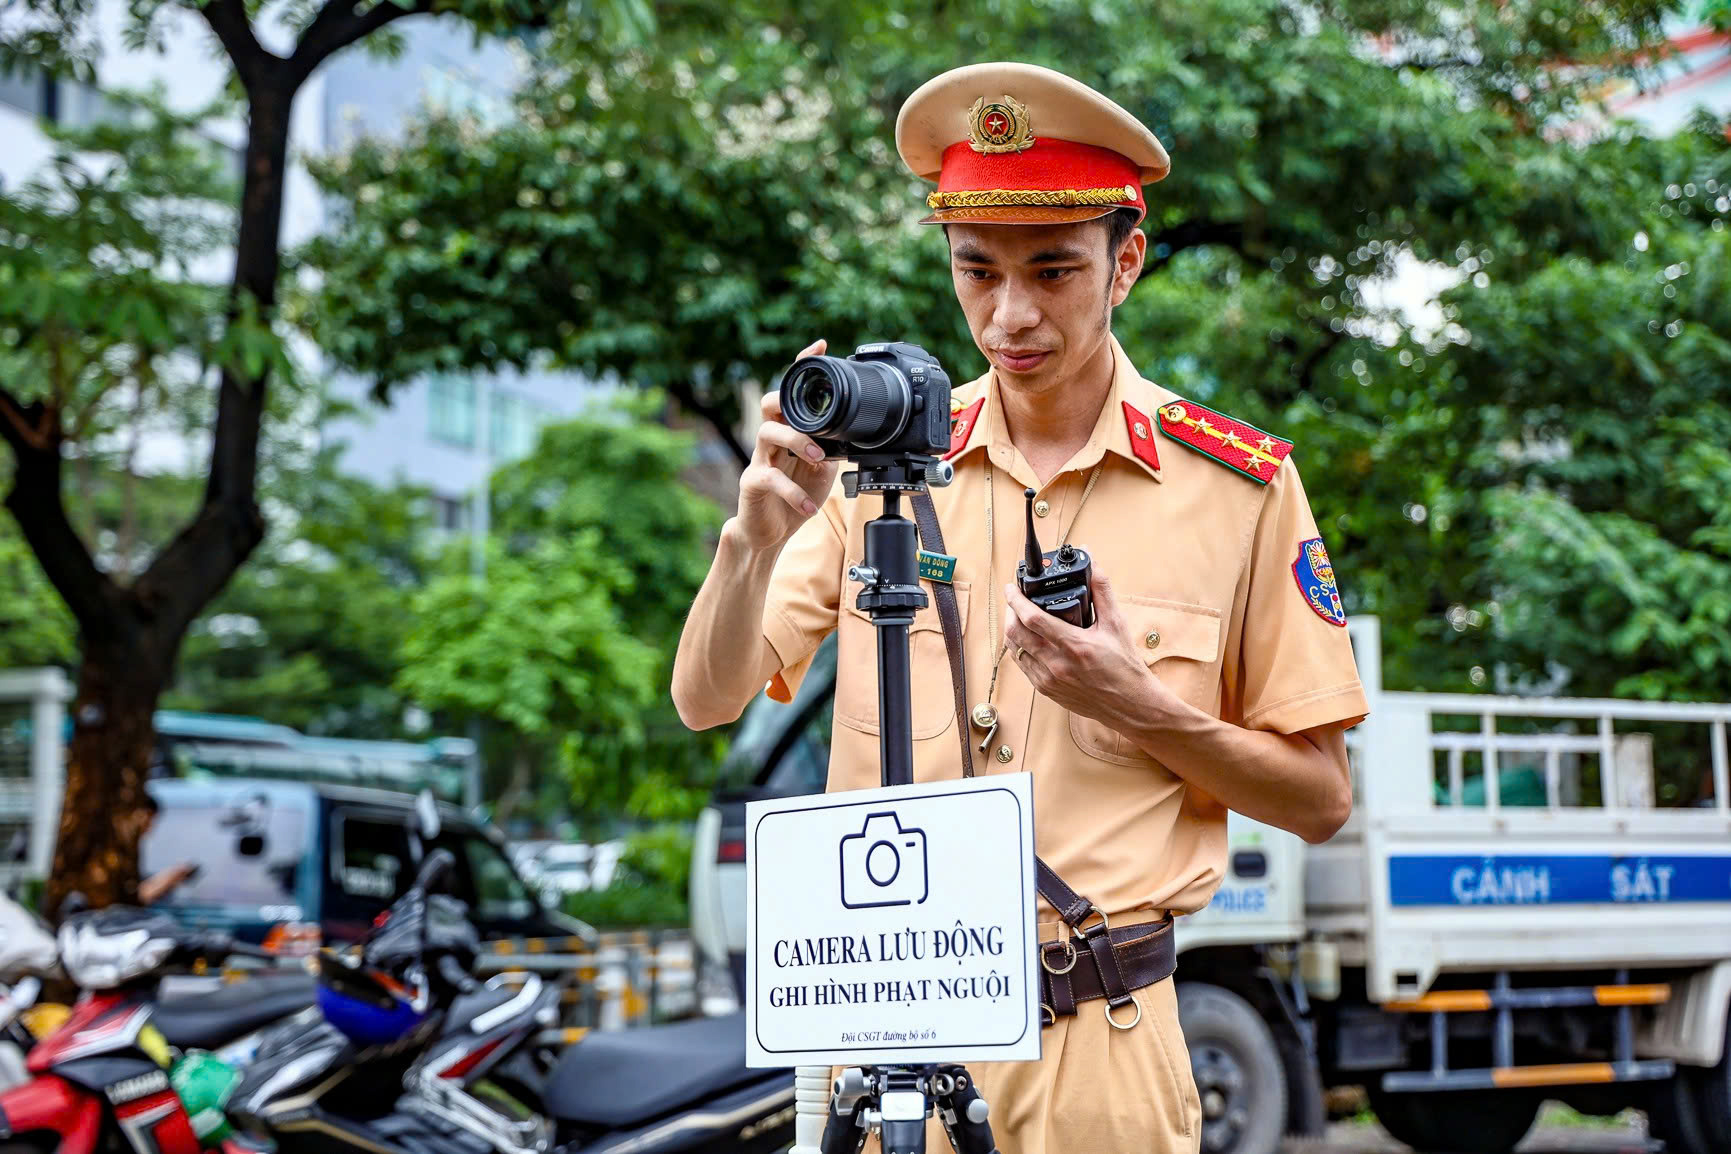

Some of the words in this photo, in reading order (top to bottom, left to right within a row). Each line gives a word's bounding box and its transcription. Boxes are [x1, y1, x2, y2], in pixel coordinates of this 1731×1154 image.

[858, 345, 885, 354] Canon
[773, 934, 872, 969] CAMERA
[878, 927, 928, 962] LƯU
[933, 919, 1004, 966] ĐỘNG
[769, 985, 808, 1008] GHI
[814, 977, 868, 1005] HÌNH
[873, 980, 931, 1008] PHẠT
[937, 969, 1011, 1004] NGUỘI
[857, 1031, 881, 1041] CSGT
[931, 1029, 937, 1039] 6
